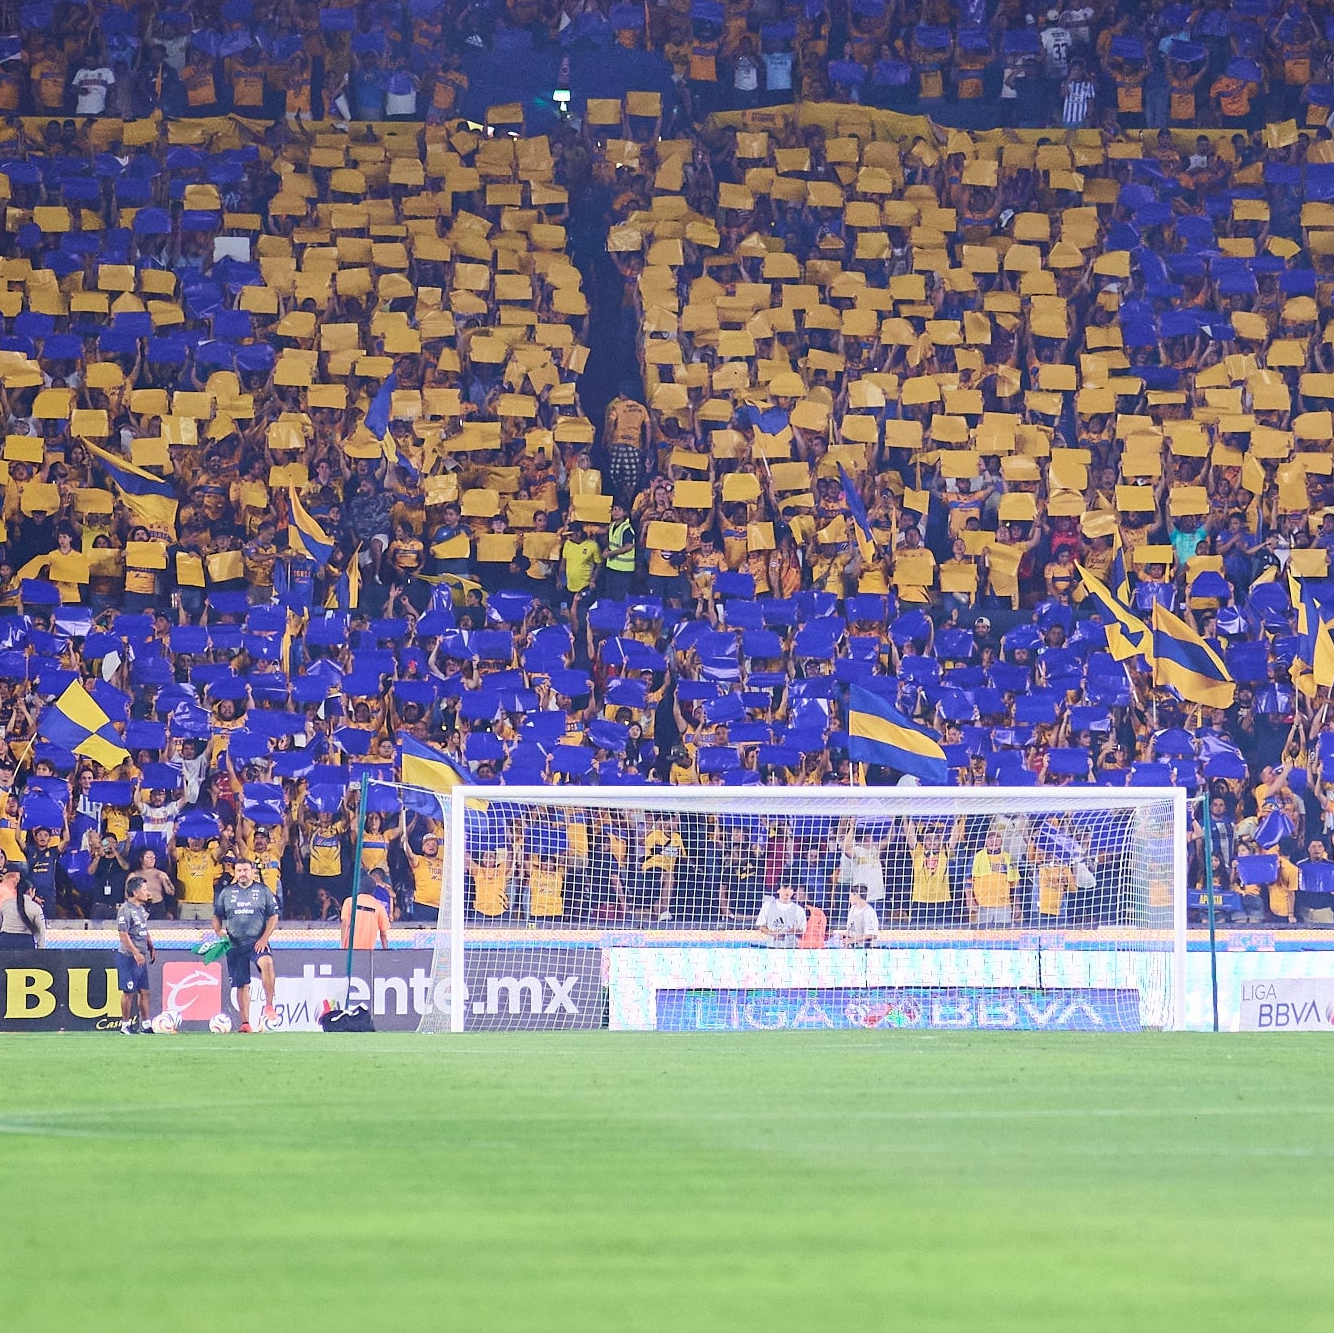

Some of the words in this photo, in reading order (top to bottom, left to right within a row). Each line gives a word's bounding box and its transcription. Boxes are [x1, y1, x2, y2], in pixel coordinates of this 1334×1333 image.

[1242, 984, 1276, 1001] LIGA
[696, 996, 836, 1030] LIGA
[932, 996, 1104, 1029] BBVA
[1258, 1001, 1321, 1028] BBVA
